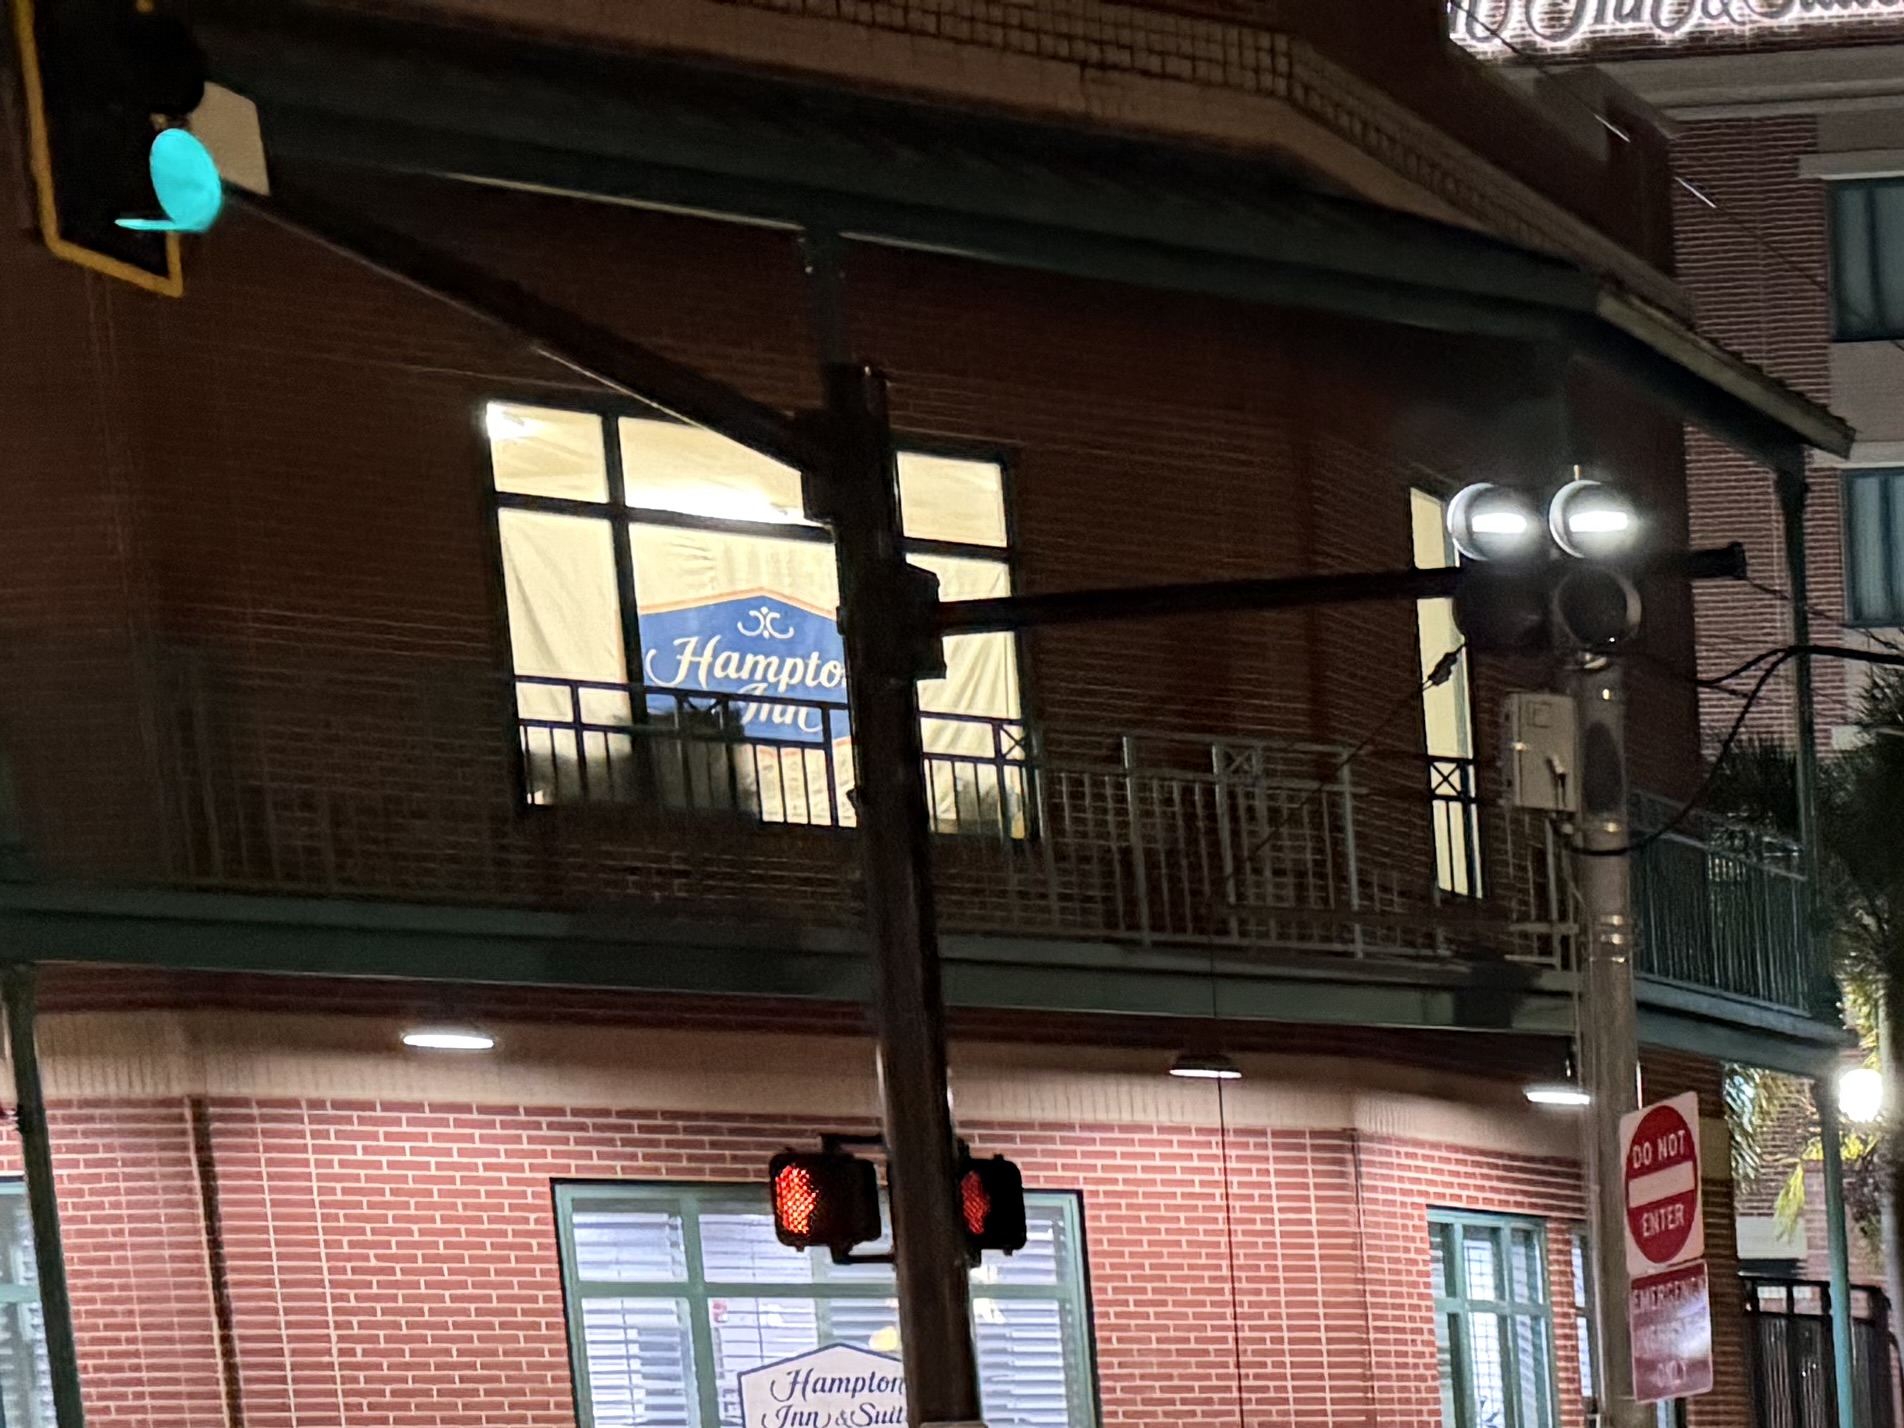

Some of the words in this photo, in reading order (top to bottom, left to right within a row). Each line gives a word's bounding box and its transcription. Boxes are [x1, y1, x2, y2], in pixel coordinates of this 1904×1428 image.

[645, 634, 847, 694] Hampto
[1632, 1141, 1651, 1169] DO
[1657, 1129, 1686, 1160] NOT
[1641, 1203, 1685, 1238] ENTER
[770, 1367, 907, 1402] Hampton
[850, 1402, 905, 1428] Suit
